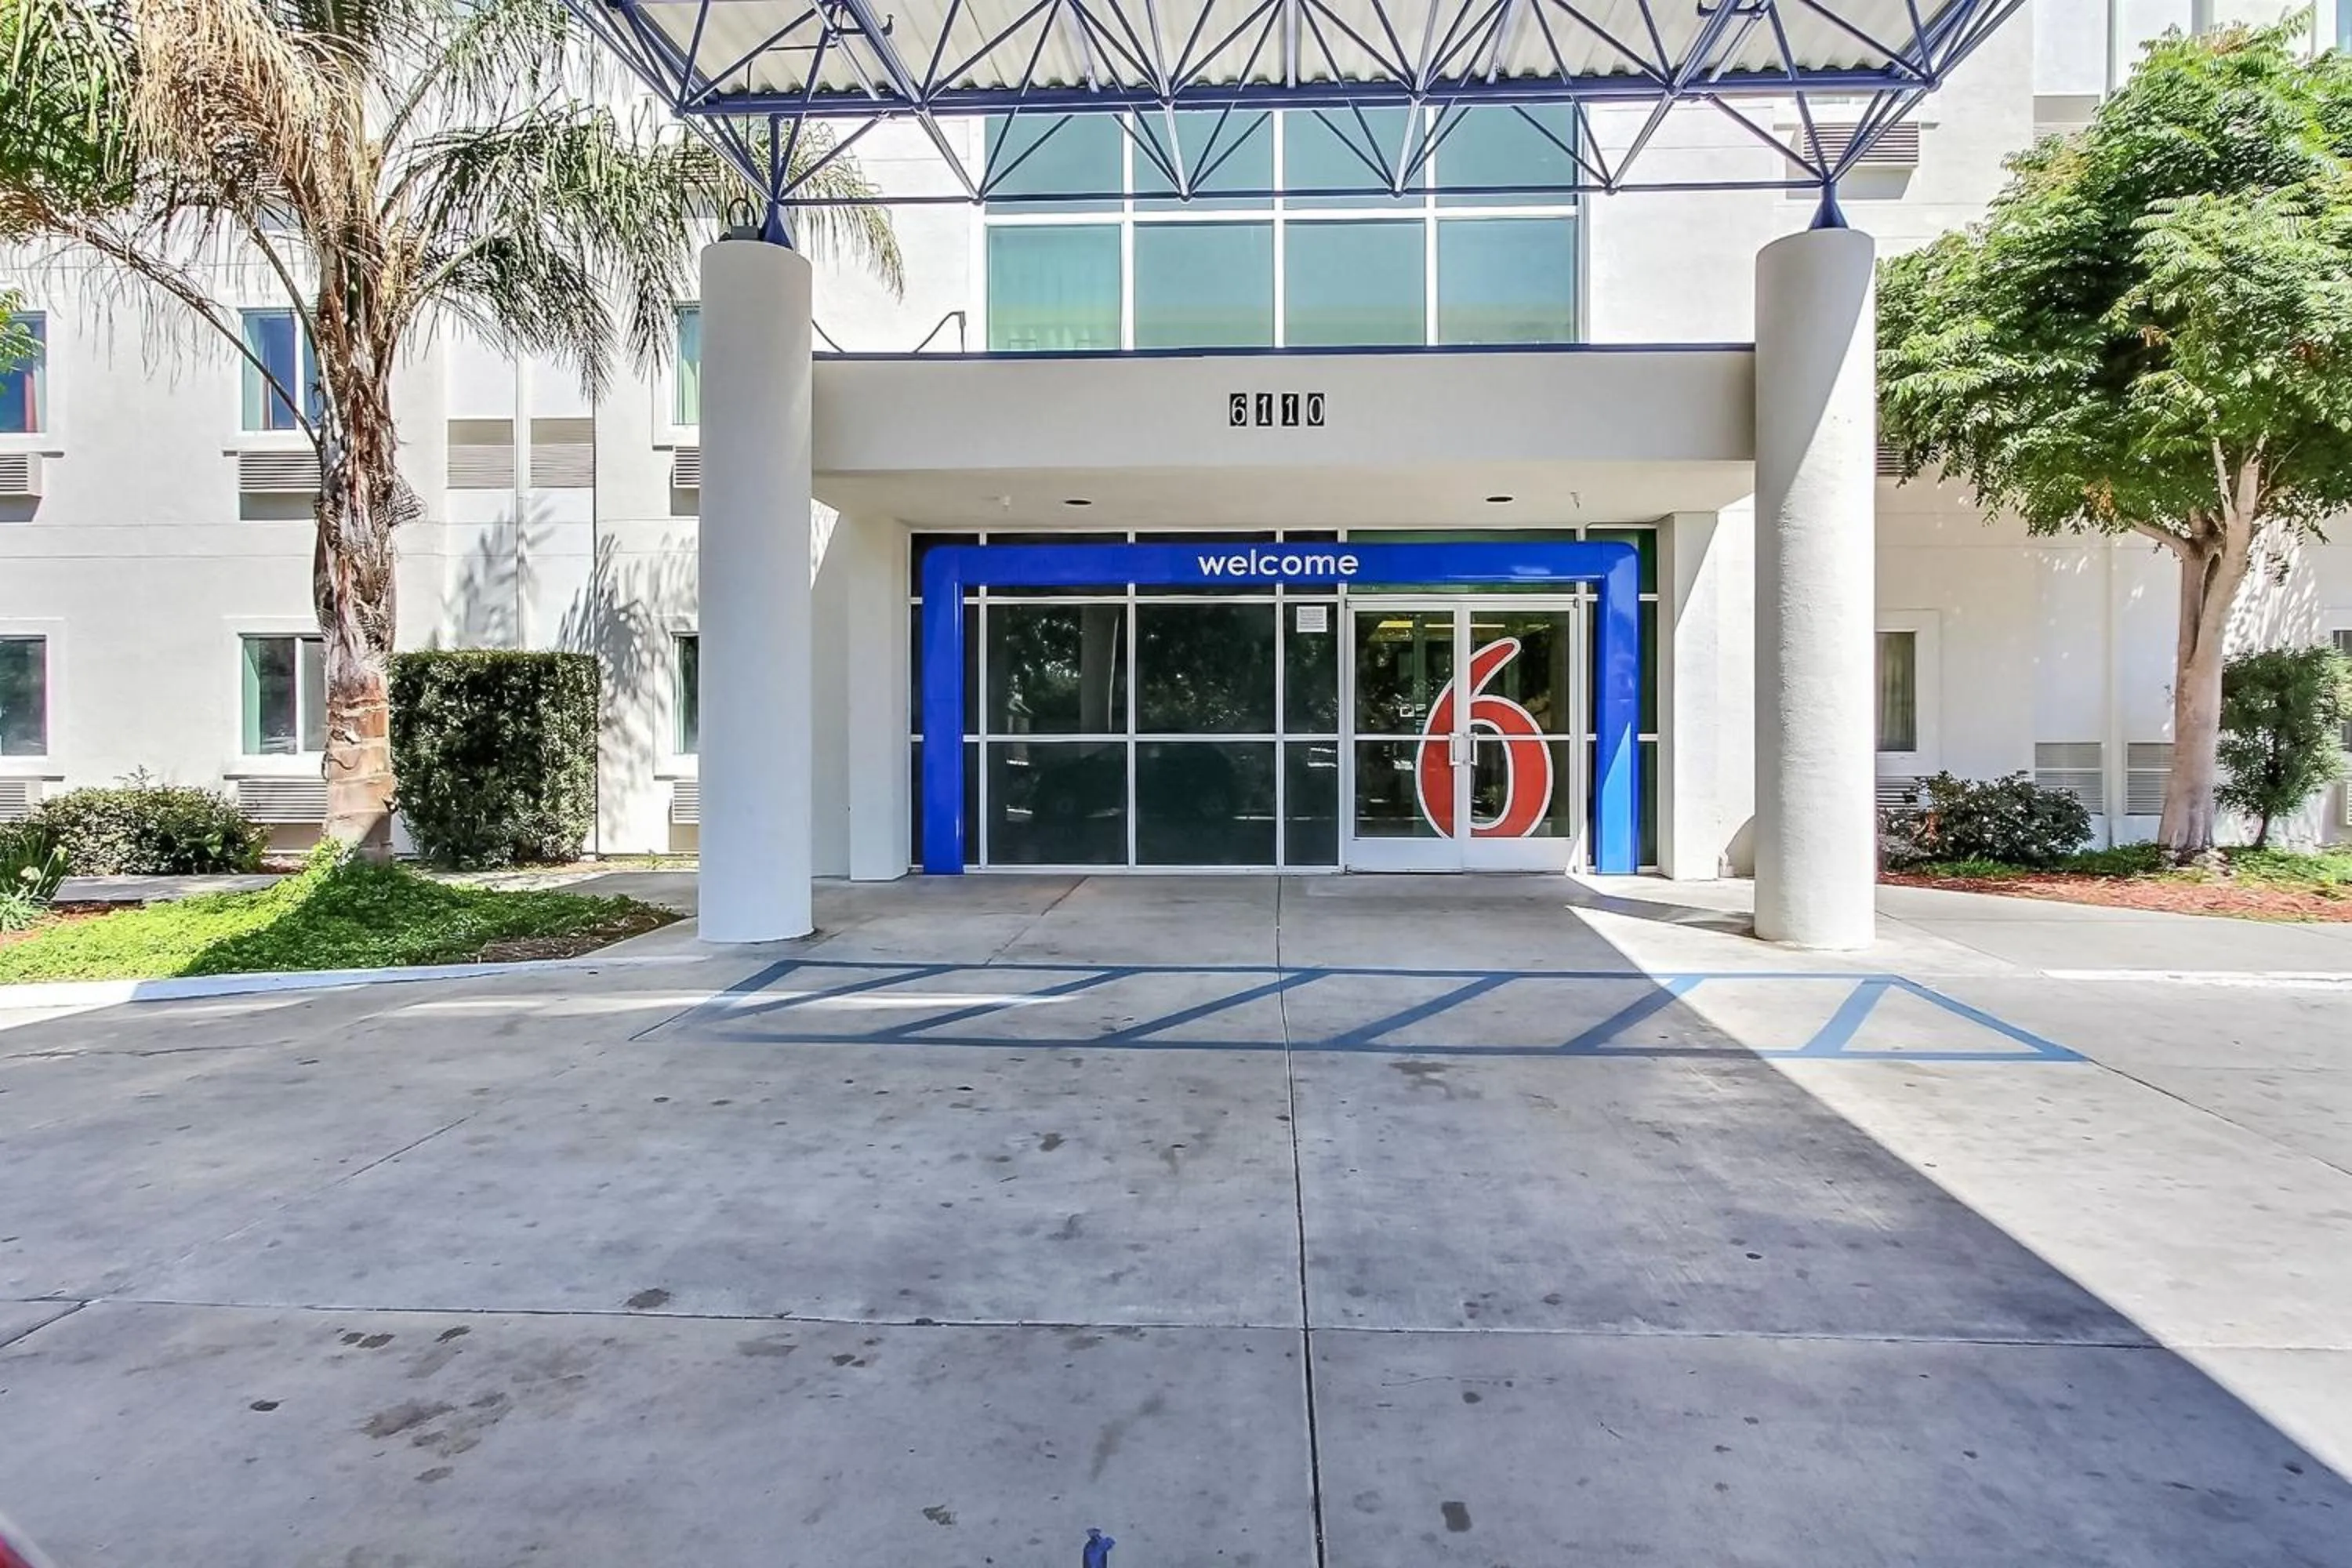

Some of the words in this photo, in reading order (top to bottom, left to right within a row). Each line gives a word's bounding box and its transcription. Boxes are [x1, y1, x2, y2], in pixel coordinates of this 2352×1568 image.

[1229, 394, 1325, 426] 6110
[1198, 549, 1359, 575] welcome
[1415, 637, 1553, 838] 6
